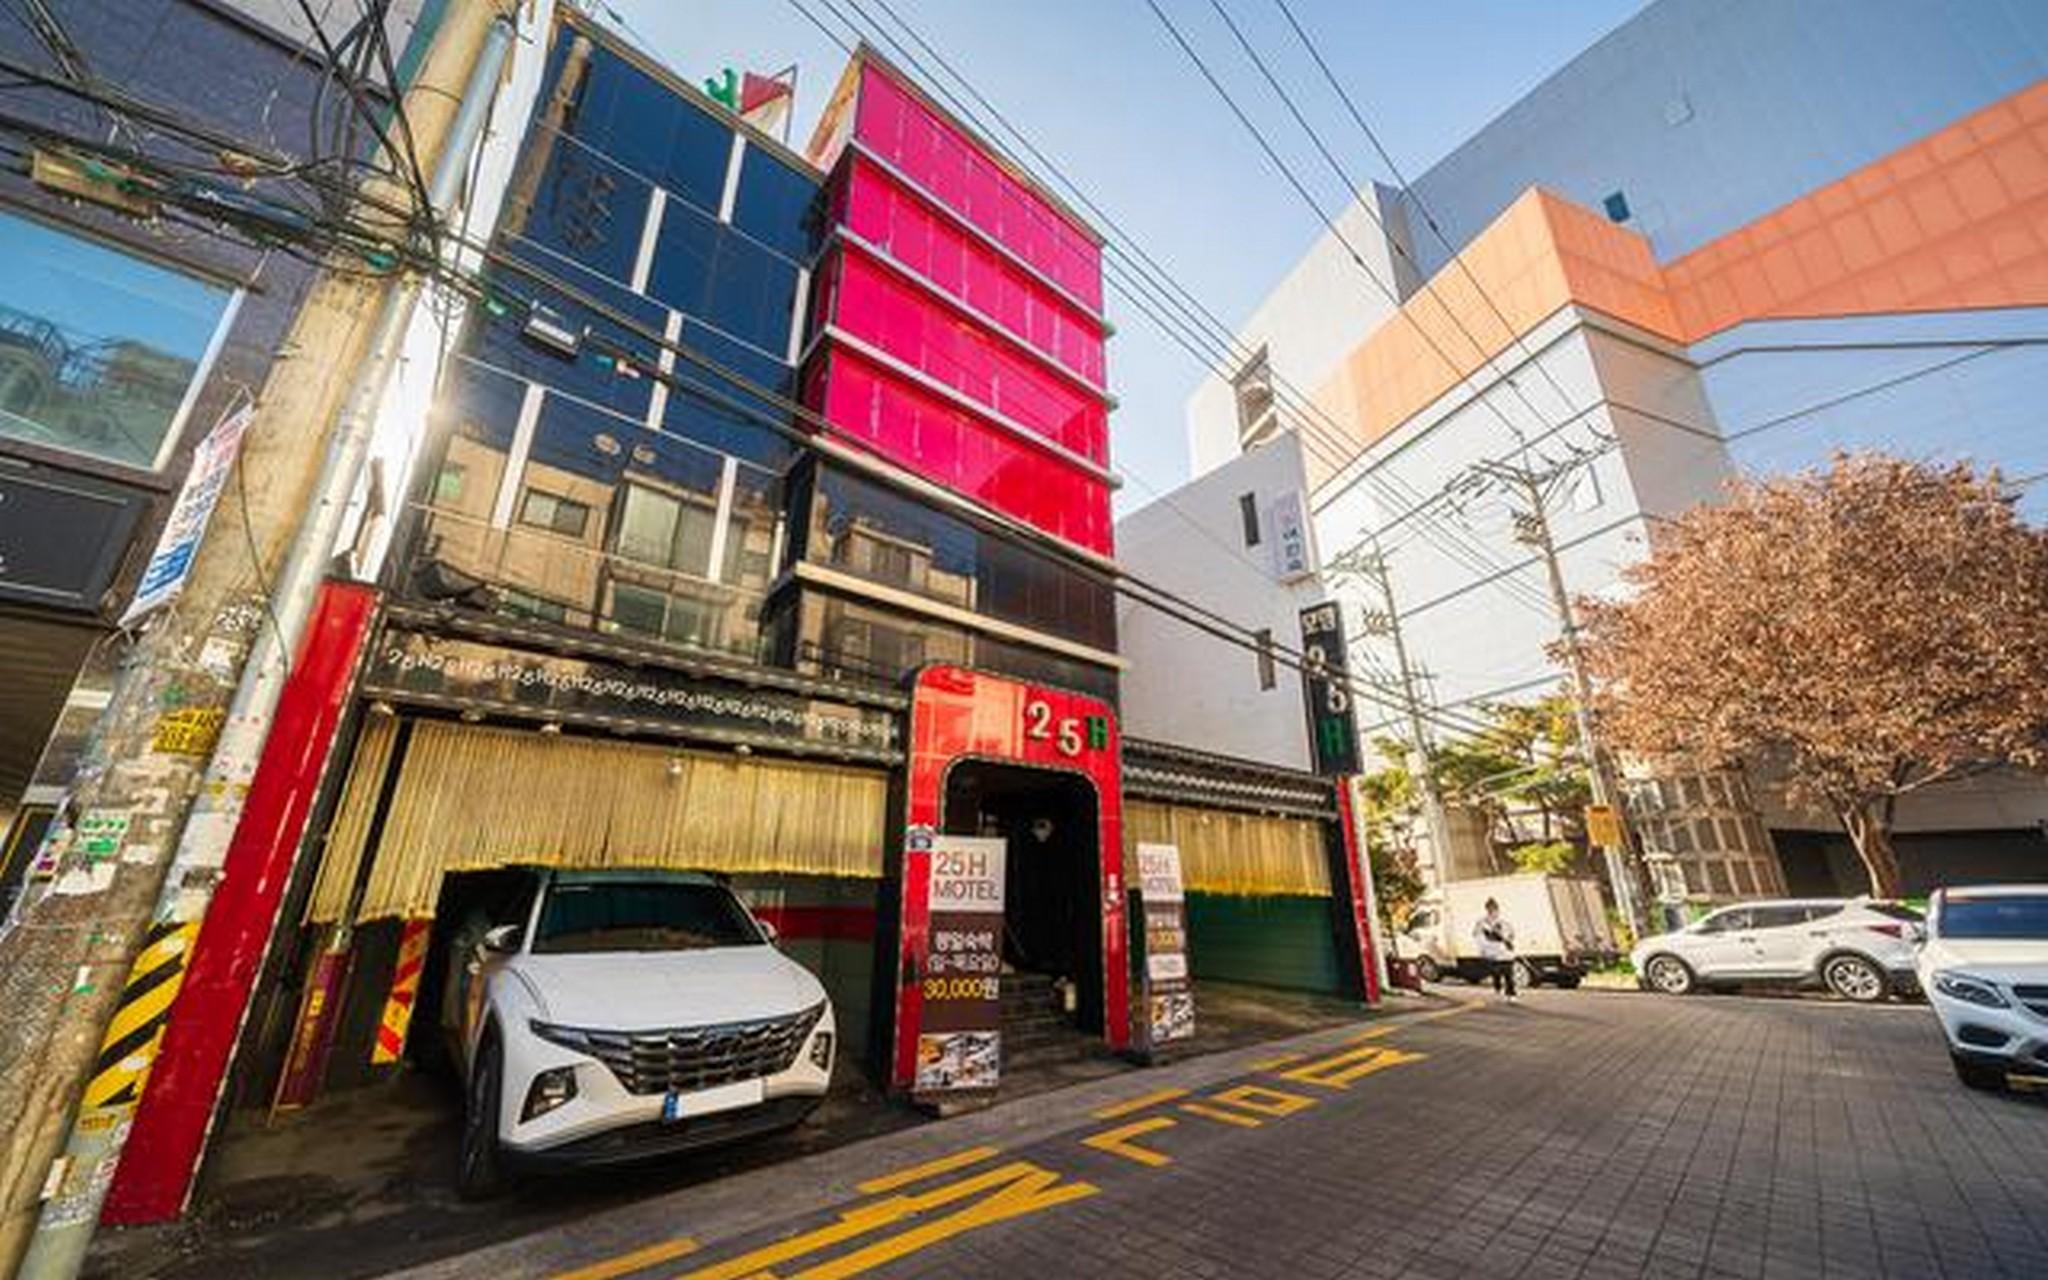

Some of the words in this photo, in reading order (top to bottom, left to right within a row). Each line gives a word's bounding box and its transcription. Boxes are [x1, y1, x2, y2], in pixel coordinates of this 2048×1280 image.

[1026, 700, 1109, 757] 25H
[934, 850, 987, 878] 25H
[933, 879, 1000, 900] MOTEL
